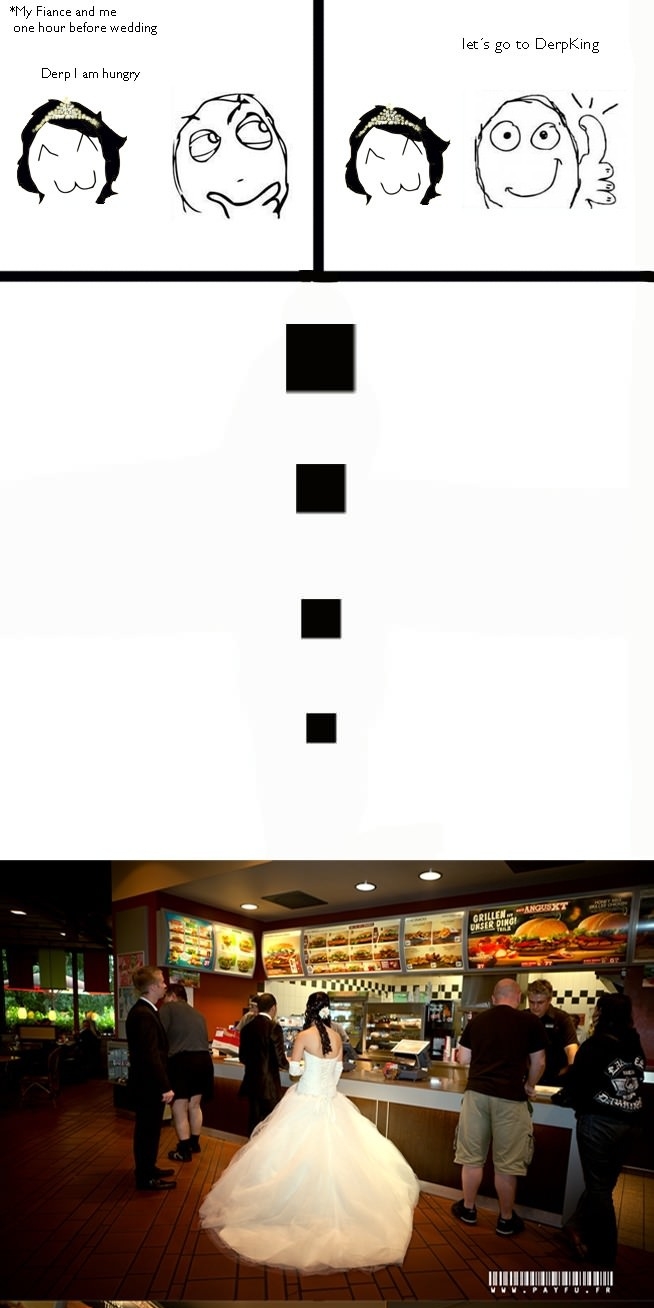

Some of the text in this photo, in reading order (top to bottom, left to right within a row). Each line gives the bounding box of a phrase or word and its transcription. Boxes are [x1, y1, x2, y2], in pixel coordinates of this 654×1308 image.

[473, 909, 506, 923] GRILLEN
[470, 917, 517, 931] UNSER DING!
